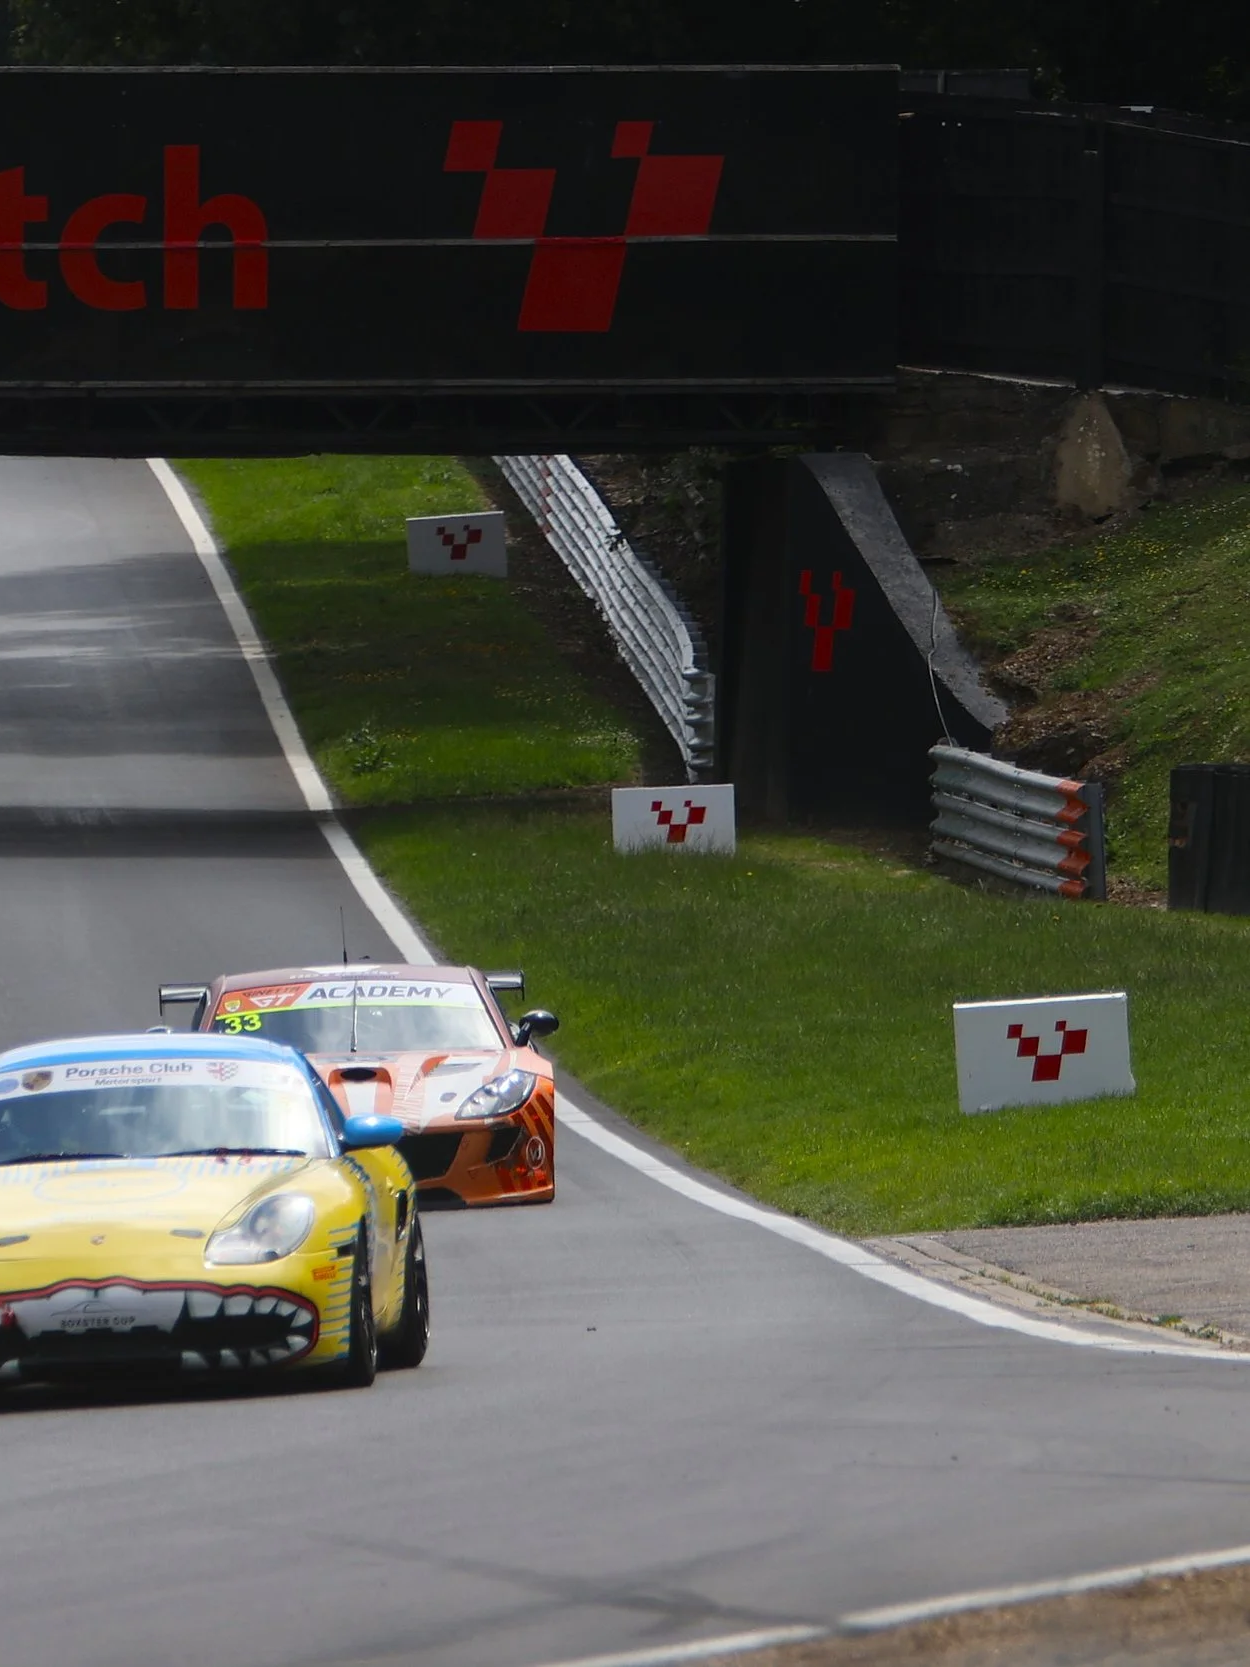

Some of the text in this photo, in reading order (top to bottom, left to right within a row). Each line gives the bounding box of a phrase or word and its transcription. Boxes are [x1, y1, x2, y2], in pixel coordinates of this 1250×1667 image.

[308, 985, 452, 1000] ACADEMY
[249, 993, 295, 1008] GT
[224, 1013, 262, 1035] 33
[65, 1062, 194, 1079] Porsche Club
[94, 1076, 162, 1087] Motorsport
